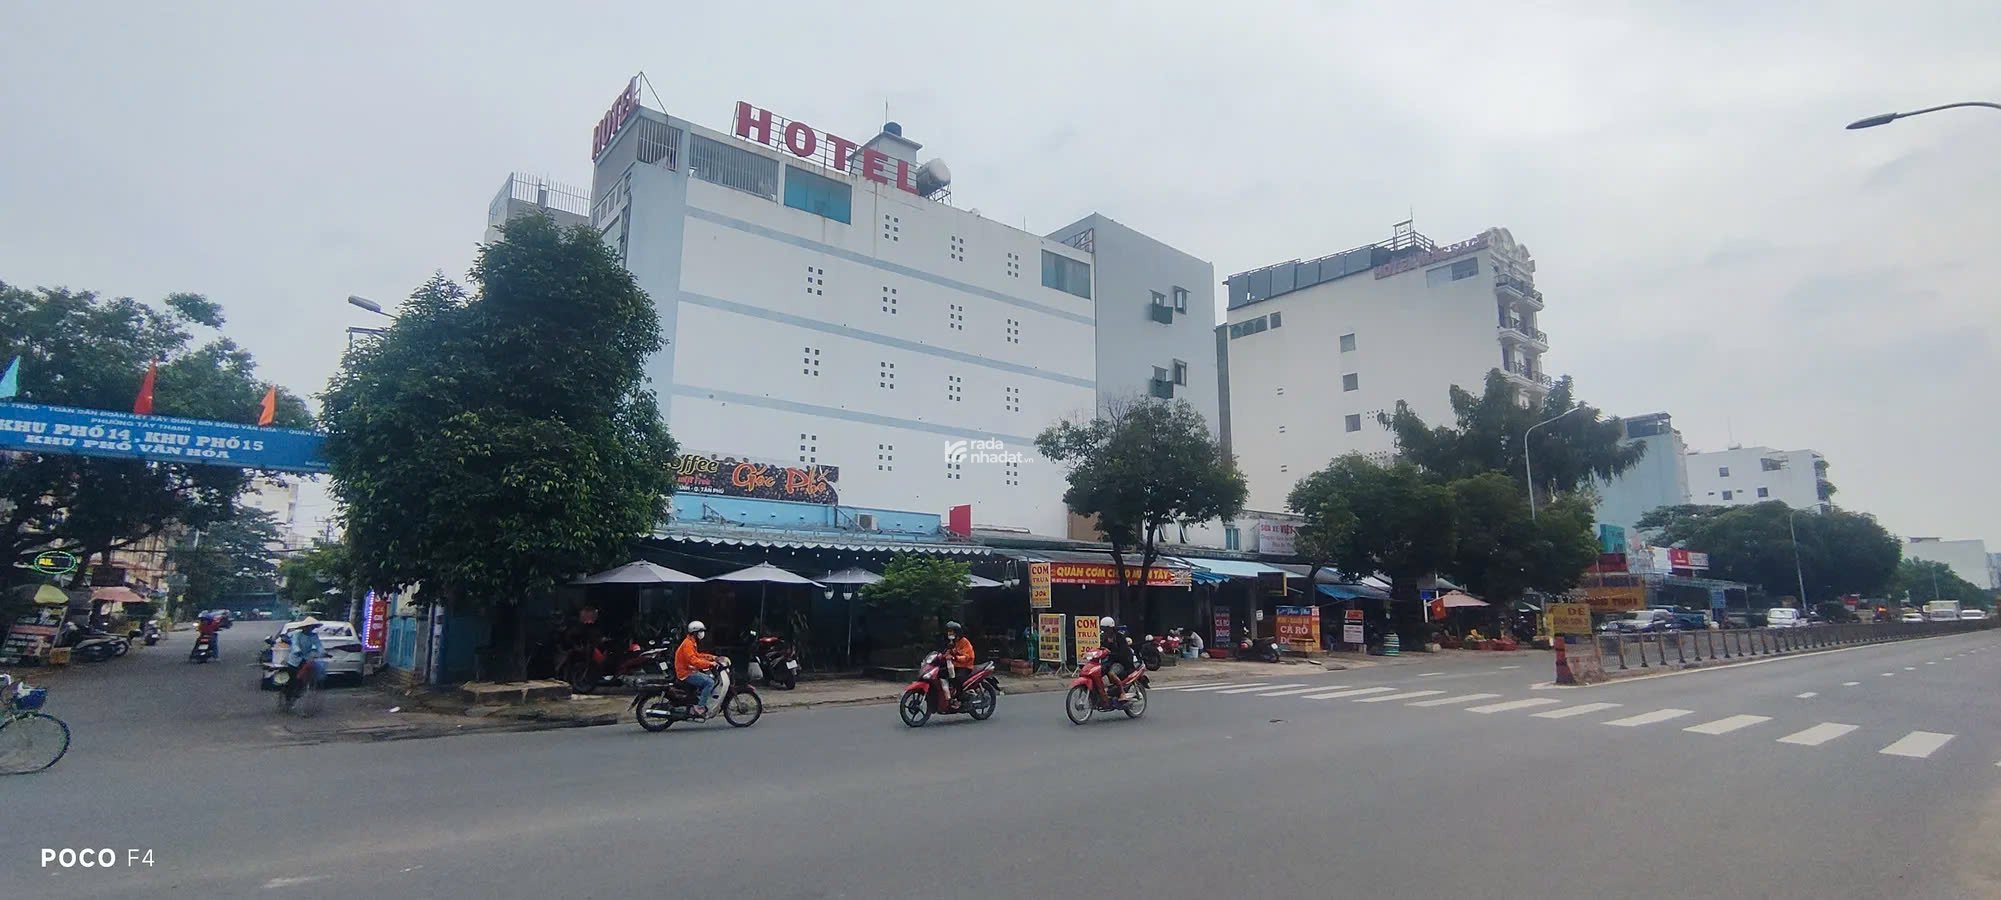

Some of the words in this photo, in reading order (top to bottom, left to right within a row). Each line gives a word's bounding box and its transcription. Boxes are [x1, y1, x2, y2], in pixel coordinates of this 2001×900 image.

[592, 76, 639, 160] HOTEL
[735, 101, 919, 194] HOTEL
[0, 418, 47, 433] KHU
[54, 424, 105, 438] PHỐ
[144, 431, 190, 446] KHU
[196, 435, 240, 450] PHỐ
[243, 440, 264, 451] 15
[25, 435, 76, 446] KHU
[83, 439, 132, 451] PHỐ
[139, 443, 181, 456] VĂN
[186, 447, 230, 459] HÓA
[732, 463, 776, 492] Góc
[1057, 565, 1083, 577] QUÁN
[1085, 567, 1106, 578] CƠM
